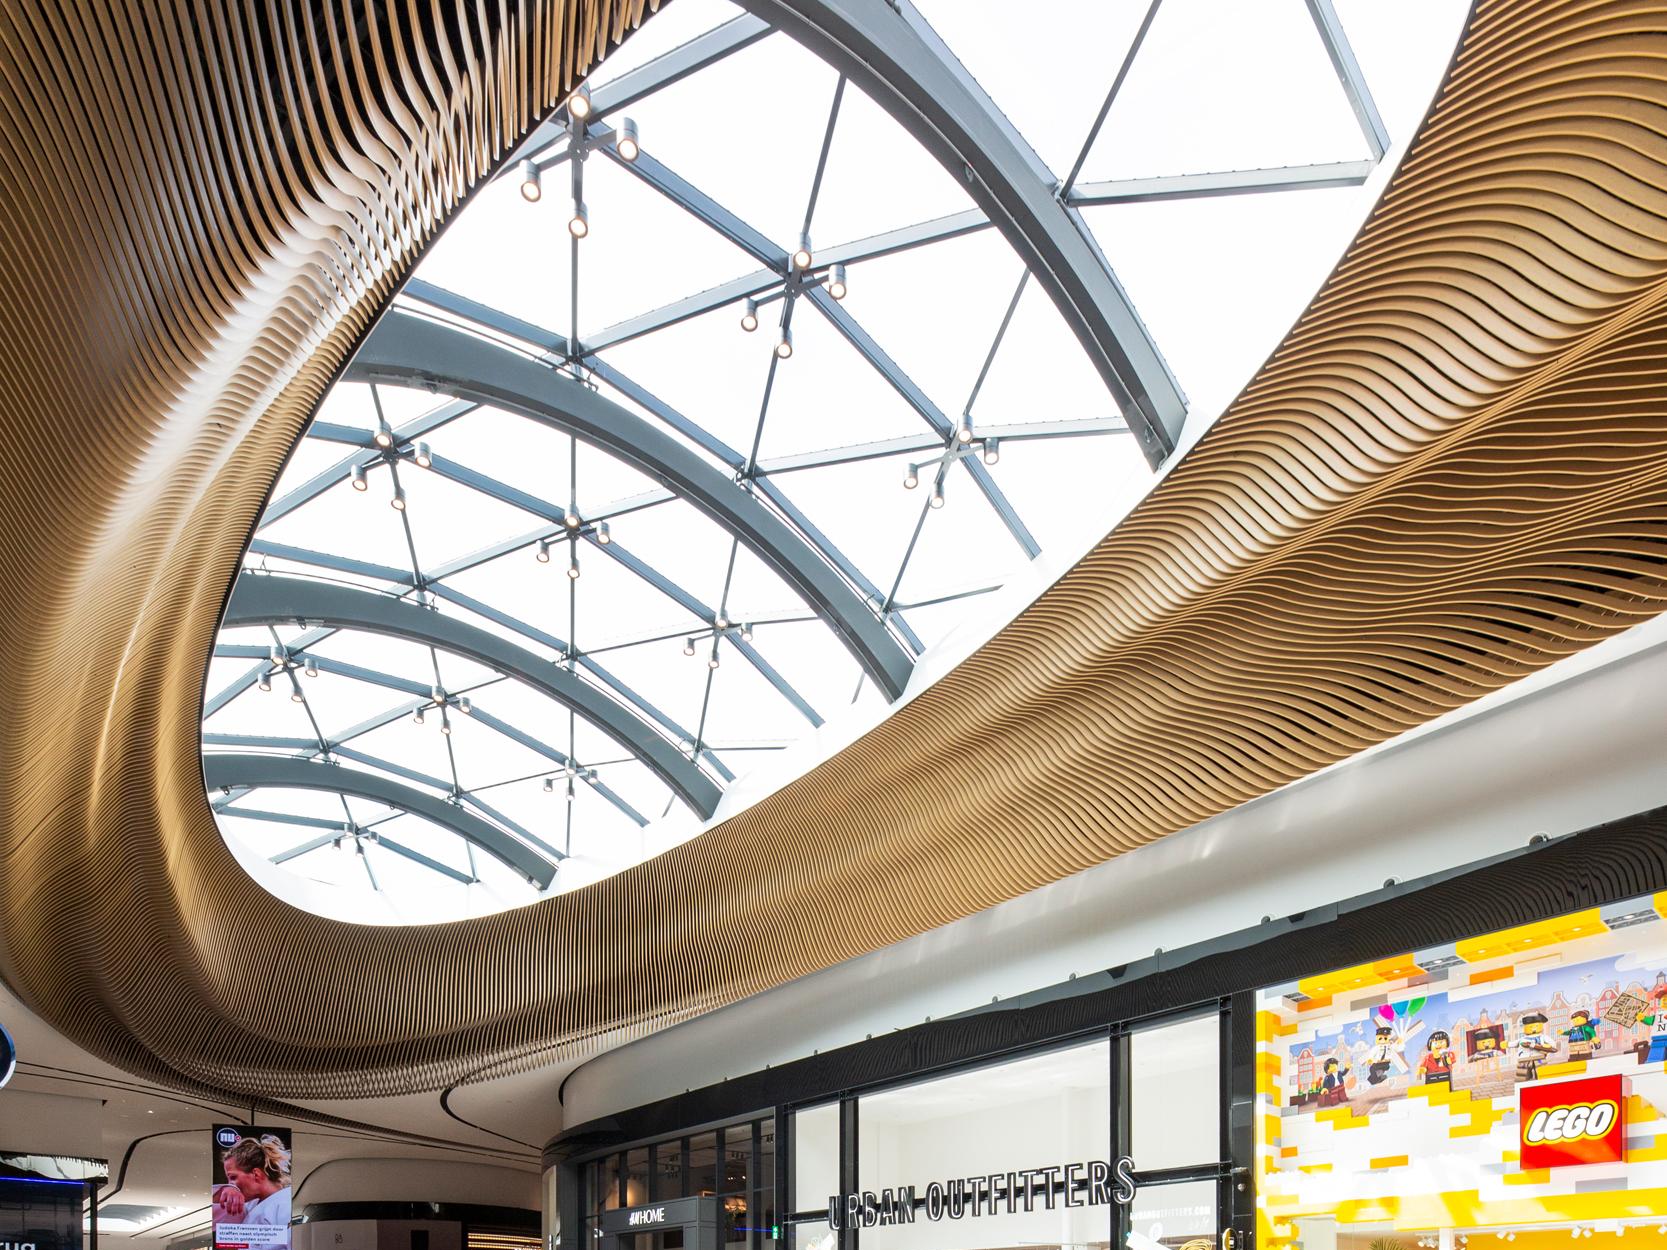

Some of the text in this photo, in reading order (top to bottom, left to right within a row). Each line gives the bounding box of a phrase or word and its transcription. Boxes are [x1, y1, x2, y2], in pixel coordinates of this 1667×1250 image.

[220, 1132, 235, 1142] nu
[1526, 1102, 1615, 1143] LEGO
[828, 1155, 1137, 1231] URBAN OUTFITTERS
[640, 1207, 665, 1224] HOME
